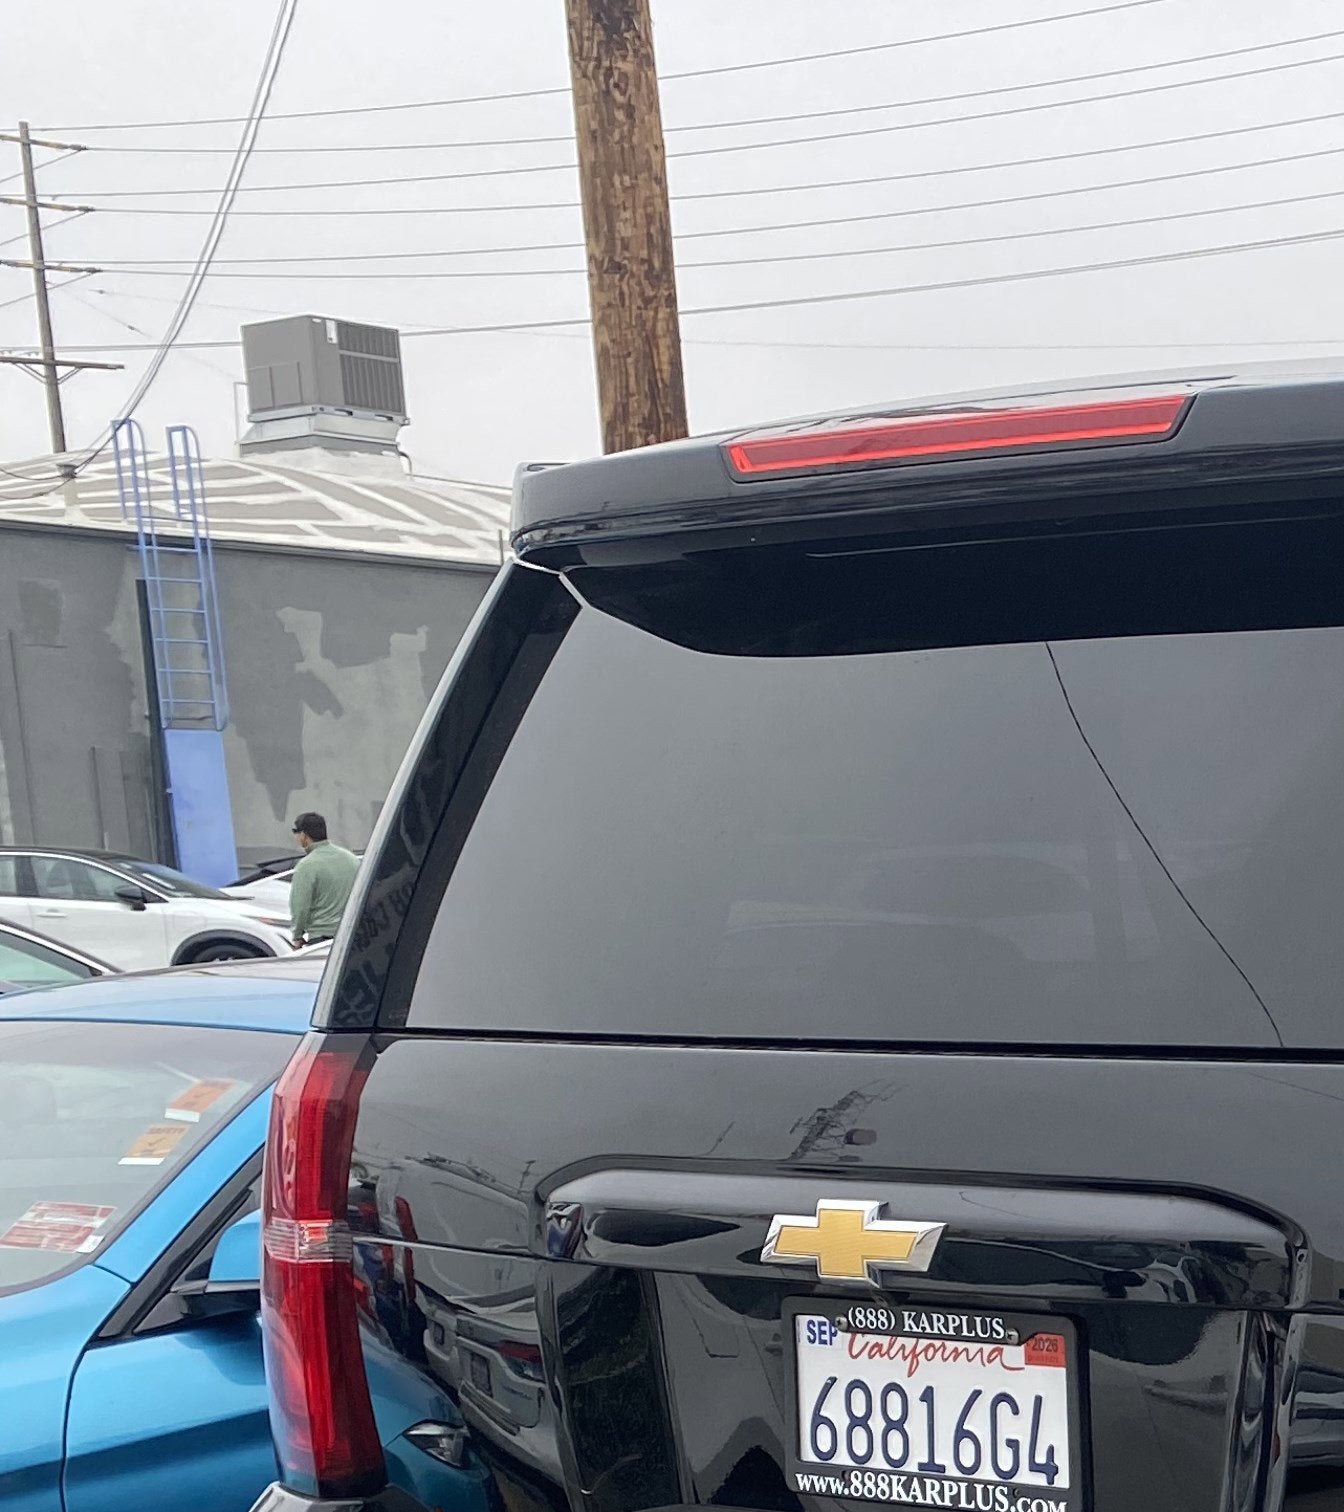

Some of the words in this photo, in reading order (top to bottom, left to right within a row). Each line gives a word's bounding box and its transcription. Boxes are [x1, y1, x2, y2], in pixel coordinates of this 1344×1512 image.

[806, 1319, 838, 1346] SEP
[848, 1307, 896, 1331] (888)
[901, 1311, 1005, 1340] KARPLUS
[847, 1332, 1026, 1378] California
[810, 1376, 1059, 1485] 68816G4
